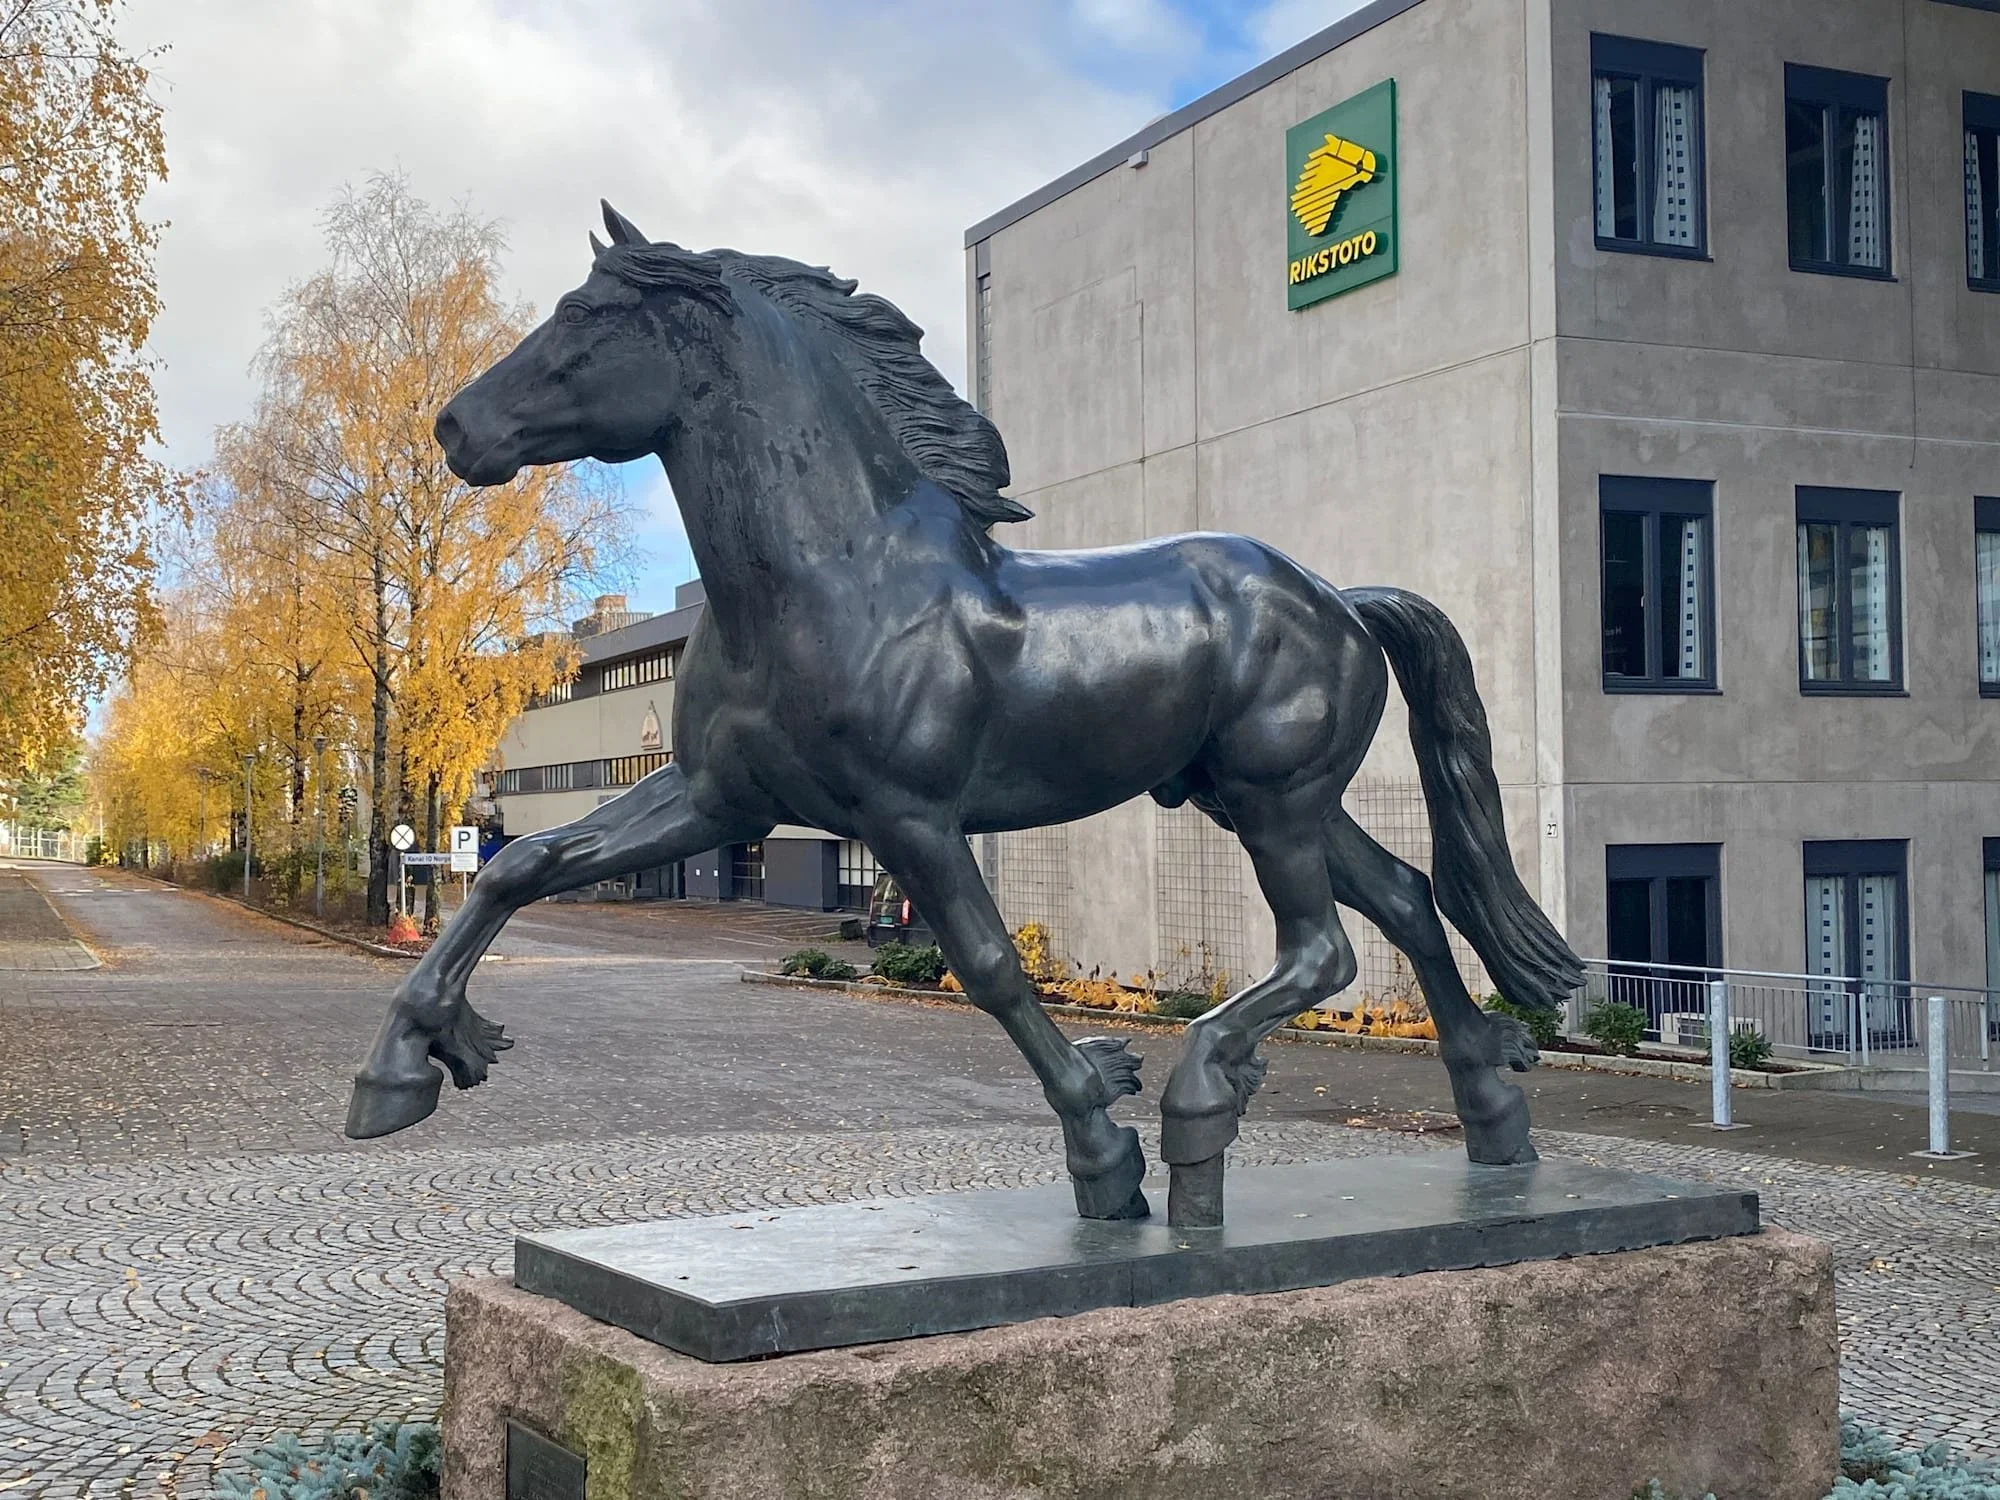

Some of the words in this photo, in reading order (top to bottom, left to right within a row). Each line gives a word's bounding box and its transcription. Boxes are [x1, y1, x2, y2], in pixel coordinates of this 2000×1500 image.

[1289, 230, 1376, 285] RIKSTOTO
[1547, 823, 1557, 835] 27
[458, 830, 471, 849] P
